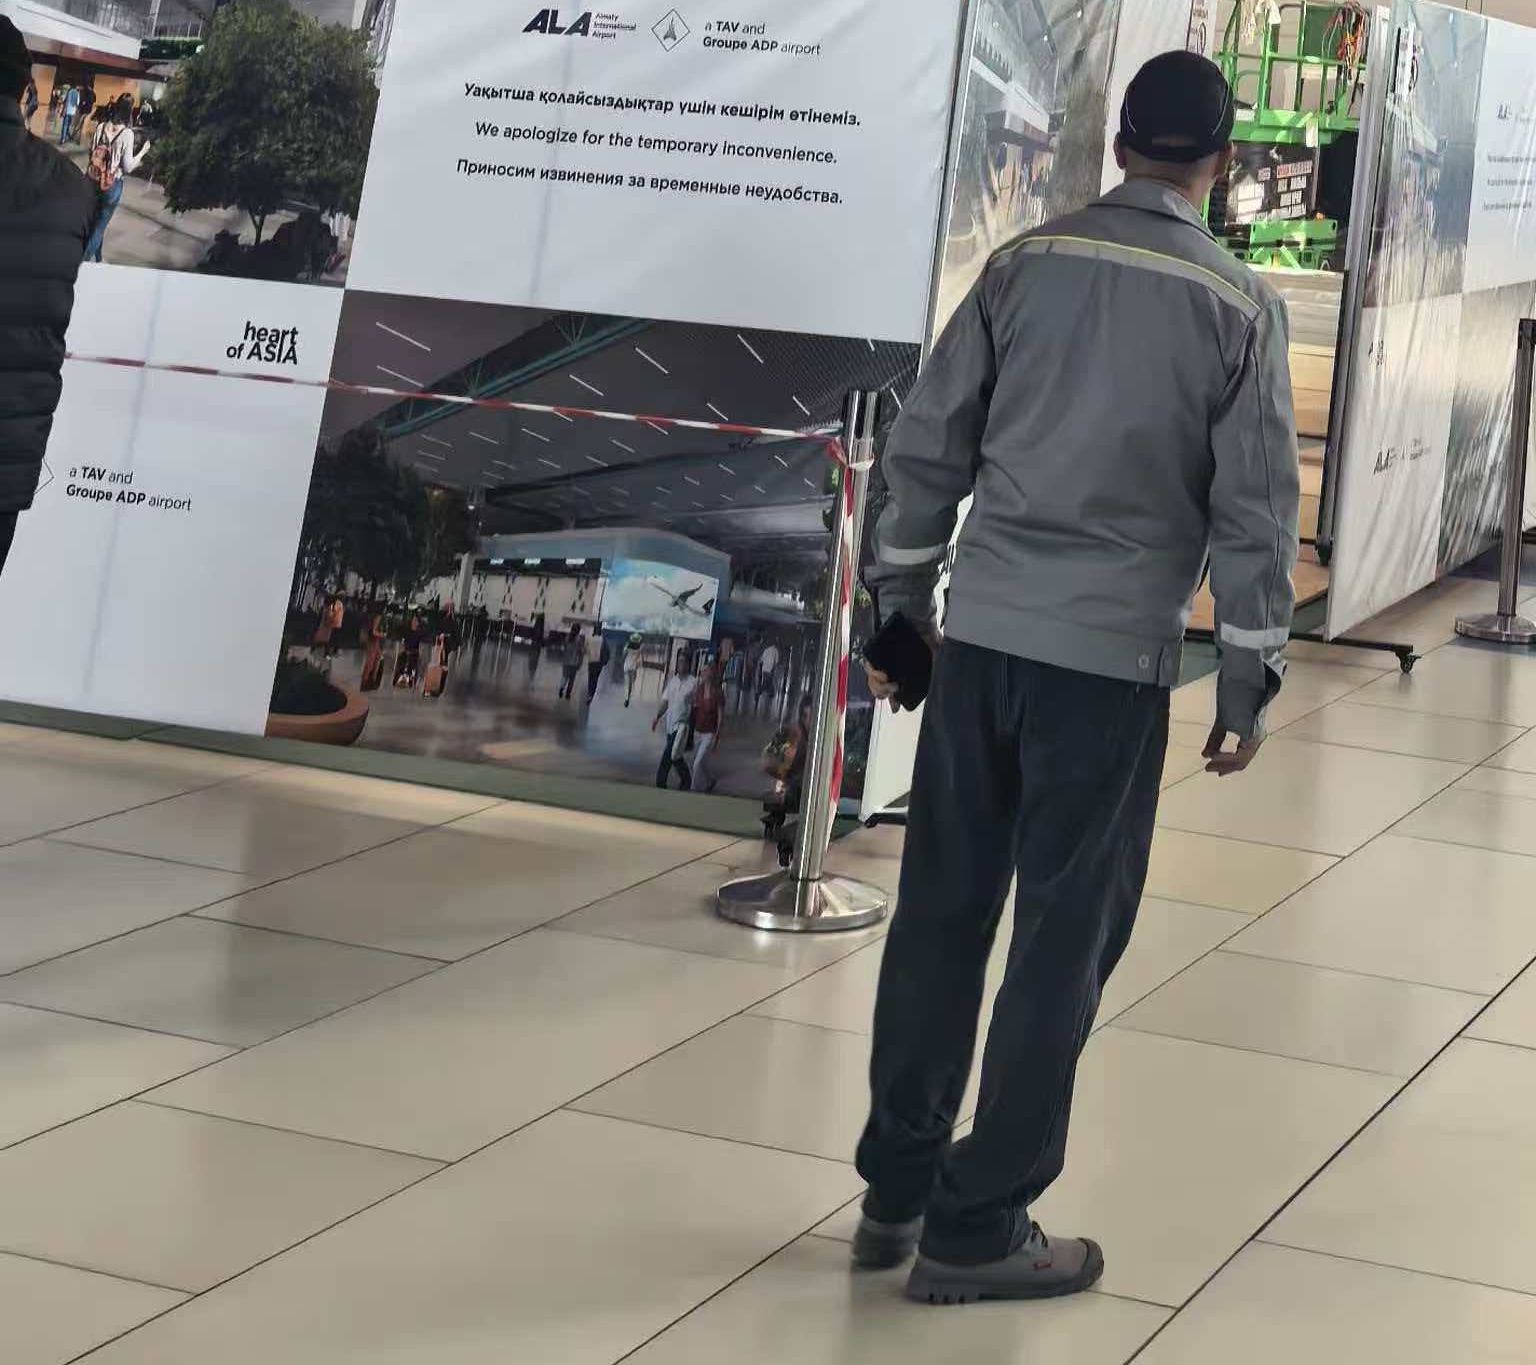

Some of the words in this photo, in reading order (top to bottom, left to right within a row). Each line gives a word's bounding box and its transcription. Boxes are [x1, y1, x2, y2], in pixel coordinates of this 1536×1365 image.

[522, 8, 592, 37] ALA
[704, 22, 712, 31] a
[715, 21, 740, 34] TAV
[742, 22, 765, 35] and
[703, 36, 747, 50] Groupe
[750, 38, 778, 52] ADP
[781, 41, 821, 56] airport
[464, 82, 534, 101] Уақытша
[539, 90, 674, 114] қолайсыздықтар
[679, 100, 716, 115] үшін
[720, 104, 784, 121] кешірім
[789, 108, 861, 126] өтінеміз.
[476, 121, 499, 136] We
[503, 126, 578, 144] apologize
[583, 129, 605, 145] for
[609, 132, 633, 147] the
[638, 134, 718, 156] temporary
[722, 141, 838, 163] inconvenience.
[456, 158, 535, 178] Приносим
[540, 169, 623, 186] извинения
[628, 175, 645, 187] за
[650, 177, 741, 195] временные
[745, 184, 843, 204] неудобства.
[244, 321, 298, 346] heart
[226, 342, 244, 359] of
[246, 341, 298, 365] ASIA
[69, 467, 77, 477] a
[81, 466, 106, 481] TAV
[108, 471, 133, 484] and
[66, 484, 113, 502] Groupe
[116, 489, 146, 505] ADP
[148, 496, 192, 511] airport
